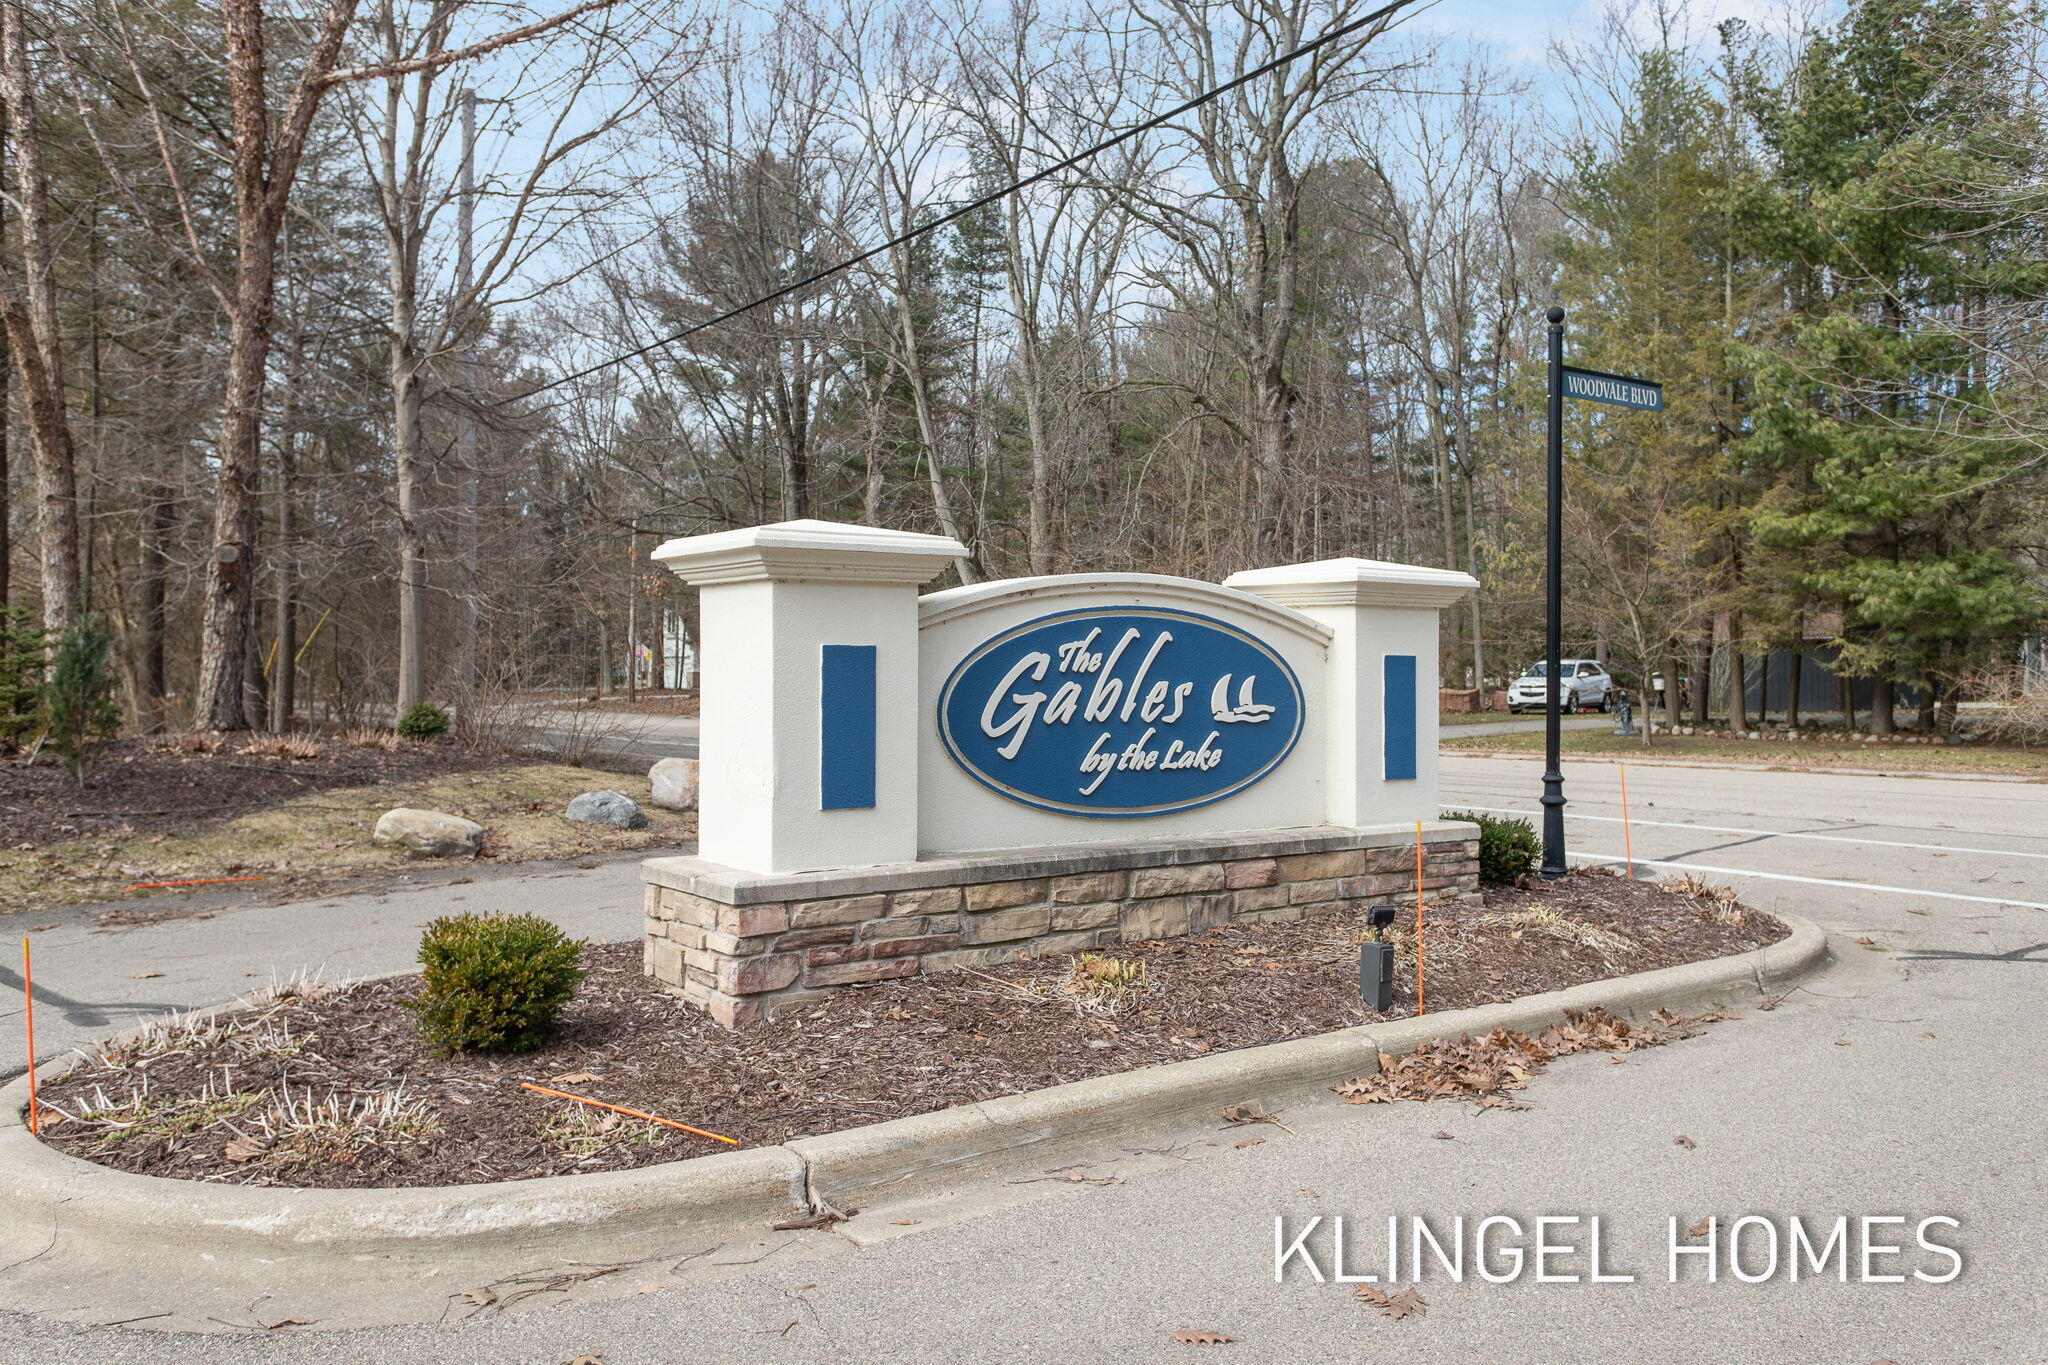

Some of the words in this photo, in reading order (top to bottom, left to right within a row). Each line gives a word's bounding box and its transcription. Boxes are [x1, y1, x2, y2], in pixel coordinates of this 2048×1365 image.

[1568, 375, 1629, 402] WOODVALE
[1631, 386, 1658, 407] BLVD
[1058, 626, 1103, 674] The
[980, 627, 1194, 760] Gables
[1078, 732, 1120, 796] by
[1117, 727, 1157, 771] the
[1160, 730, 1223, 771] Lake
